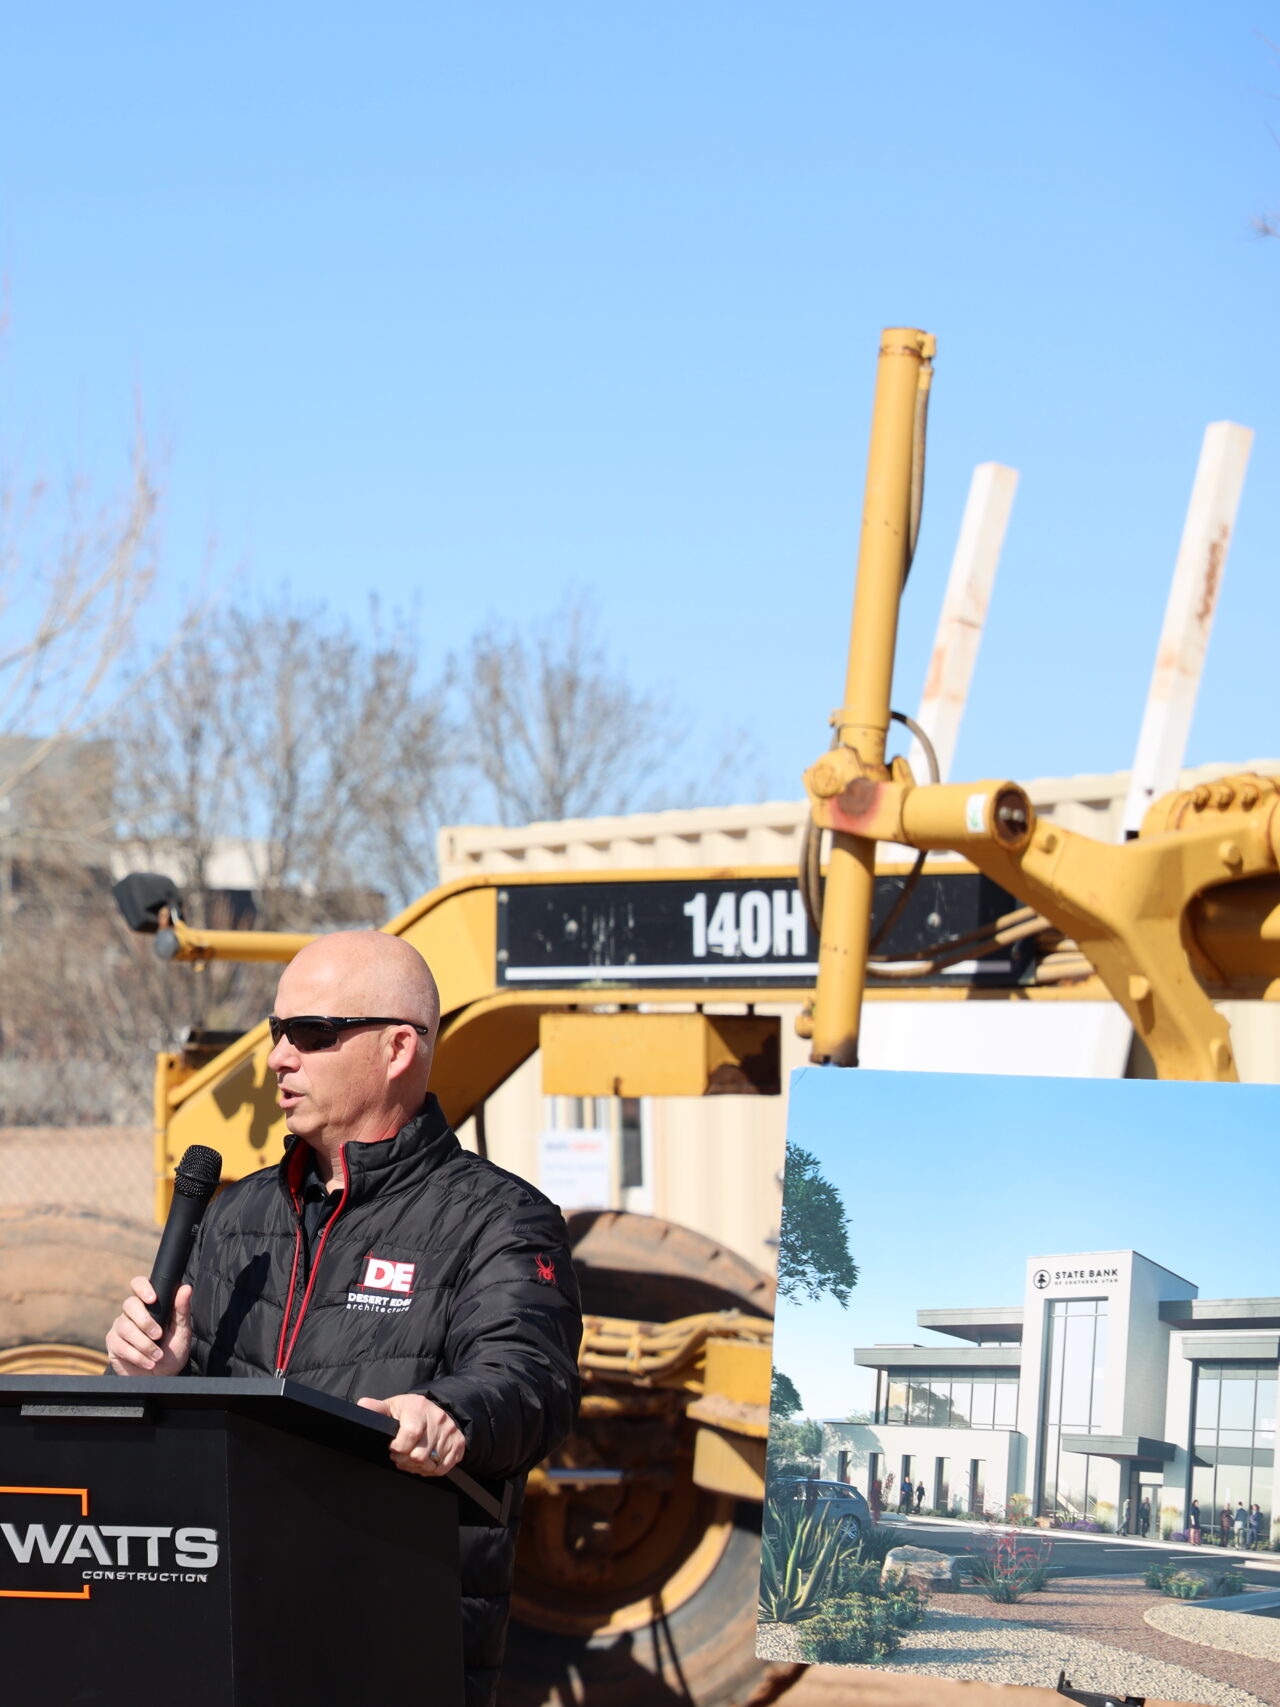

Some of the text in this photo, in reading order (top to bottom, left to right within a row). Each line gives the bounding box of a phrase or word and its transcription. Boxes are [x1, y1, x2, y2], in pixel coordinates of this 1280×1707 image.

[683, 889, 808, 958] 140H
[363, 1258, 415, 1292] DE
[1055, 1269, 1118, 1279] STATE BANK
[348, 1293, 389, 1305] DESERT
[346, 1303, 410, 1314] architecture
[0, 1522, 218, 1569] WATTS
[82, 1570, 208, 1583] CONSTRUCTION
